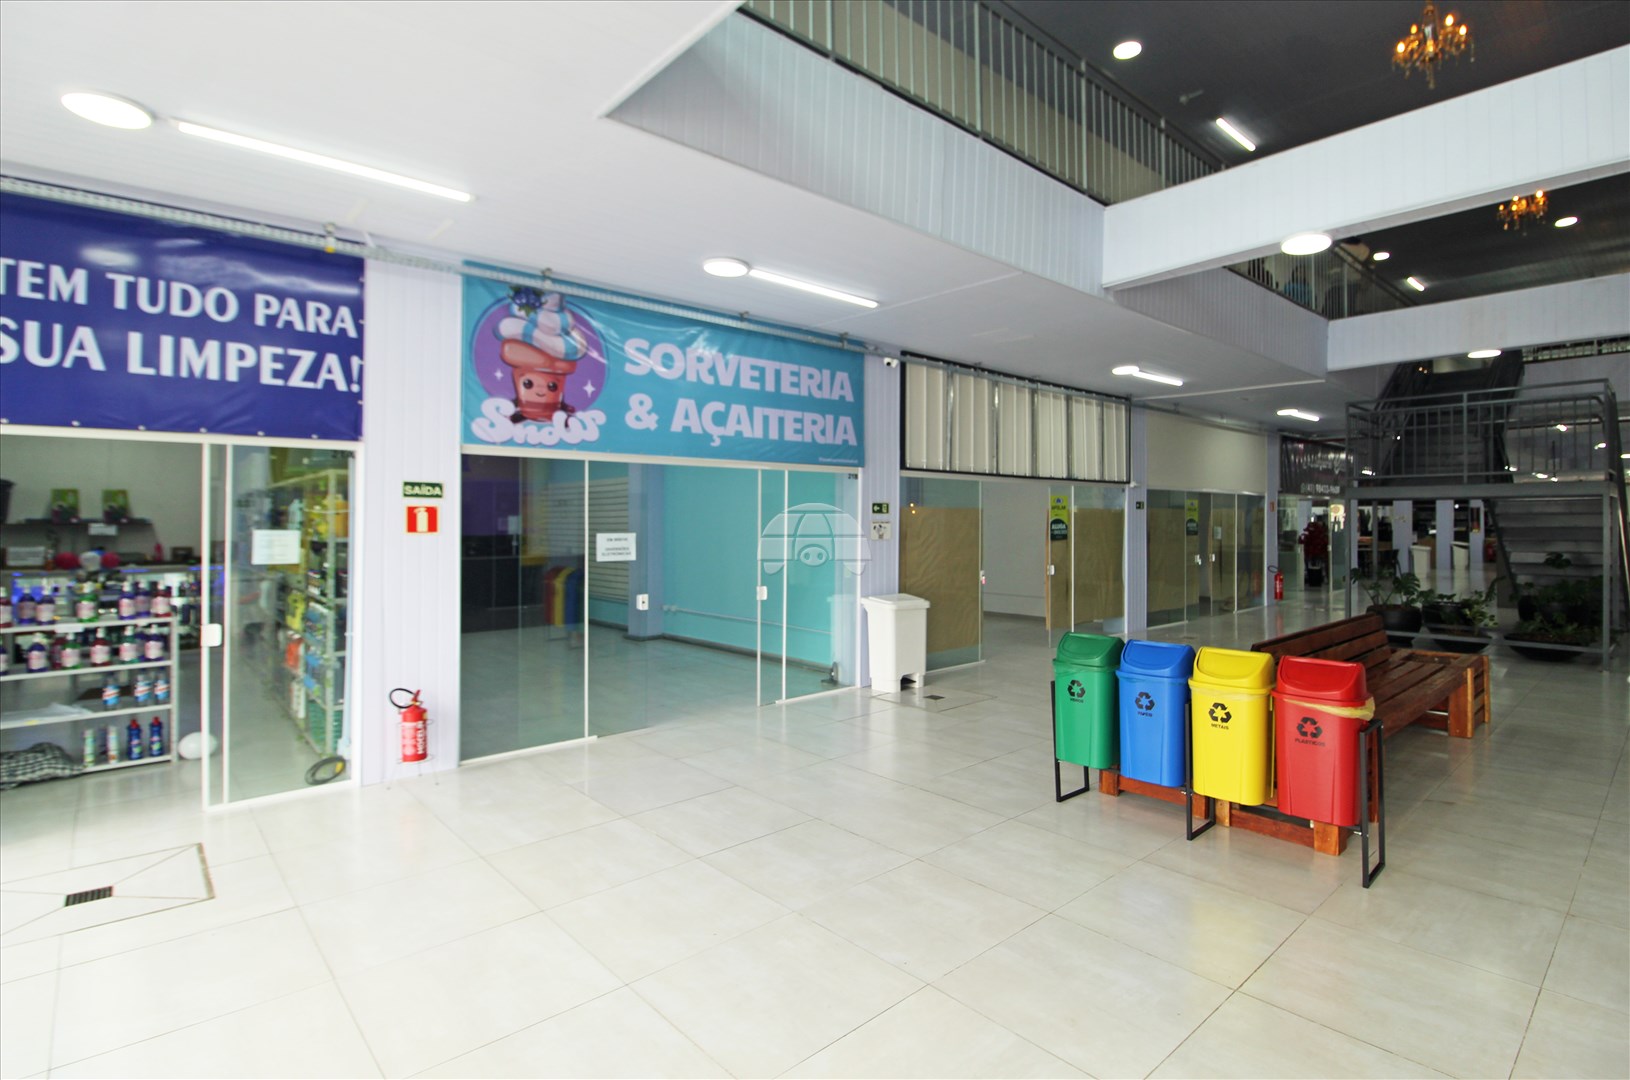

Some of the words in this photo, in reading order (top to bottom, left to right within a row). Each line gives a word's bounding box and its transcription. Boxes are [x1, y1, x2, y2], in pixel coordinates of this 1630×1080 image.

[0, 257, 88, 305] TEM
[105, 272, 239, 322] TUDO
[254, 293, 358, 338] PARA
[0, 316, 106, 371] SUA
[127, 331, 361, 393] LIMPEZA!
[624, 338, 854, 402] SORVETERIA
[625, 393, 658, 431] &
[669, 398, 857, 446] AÇAITERIA
[404, 483, 442, 496] SAÍDA
